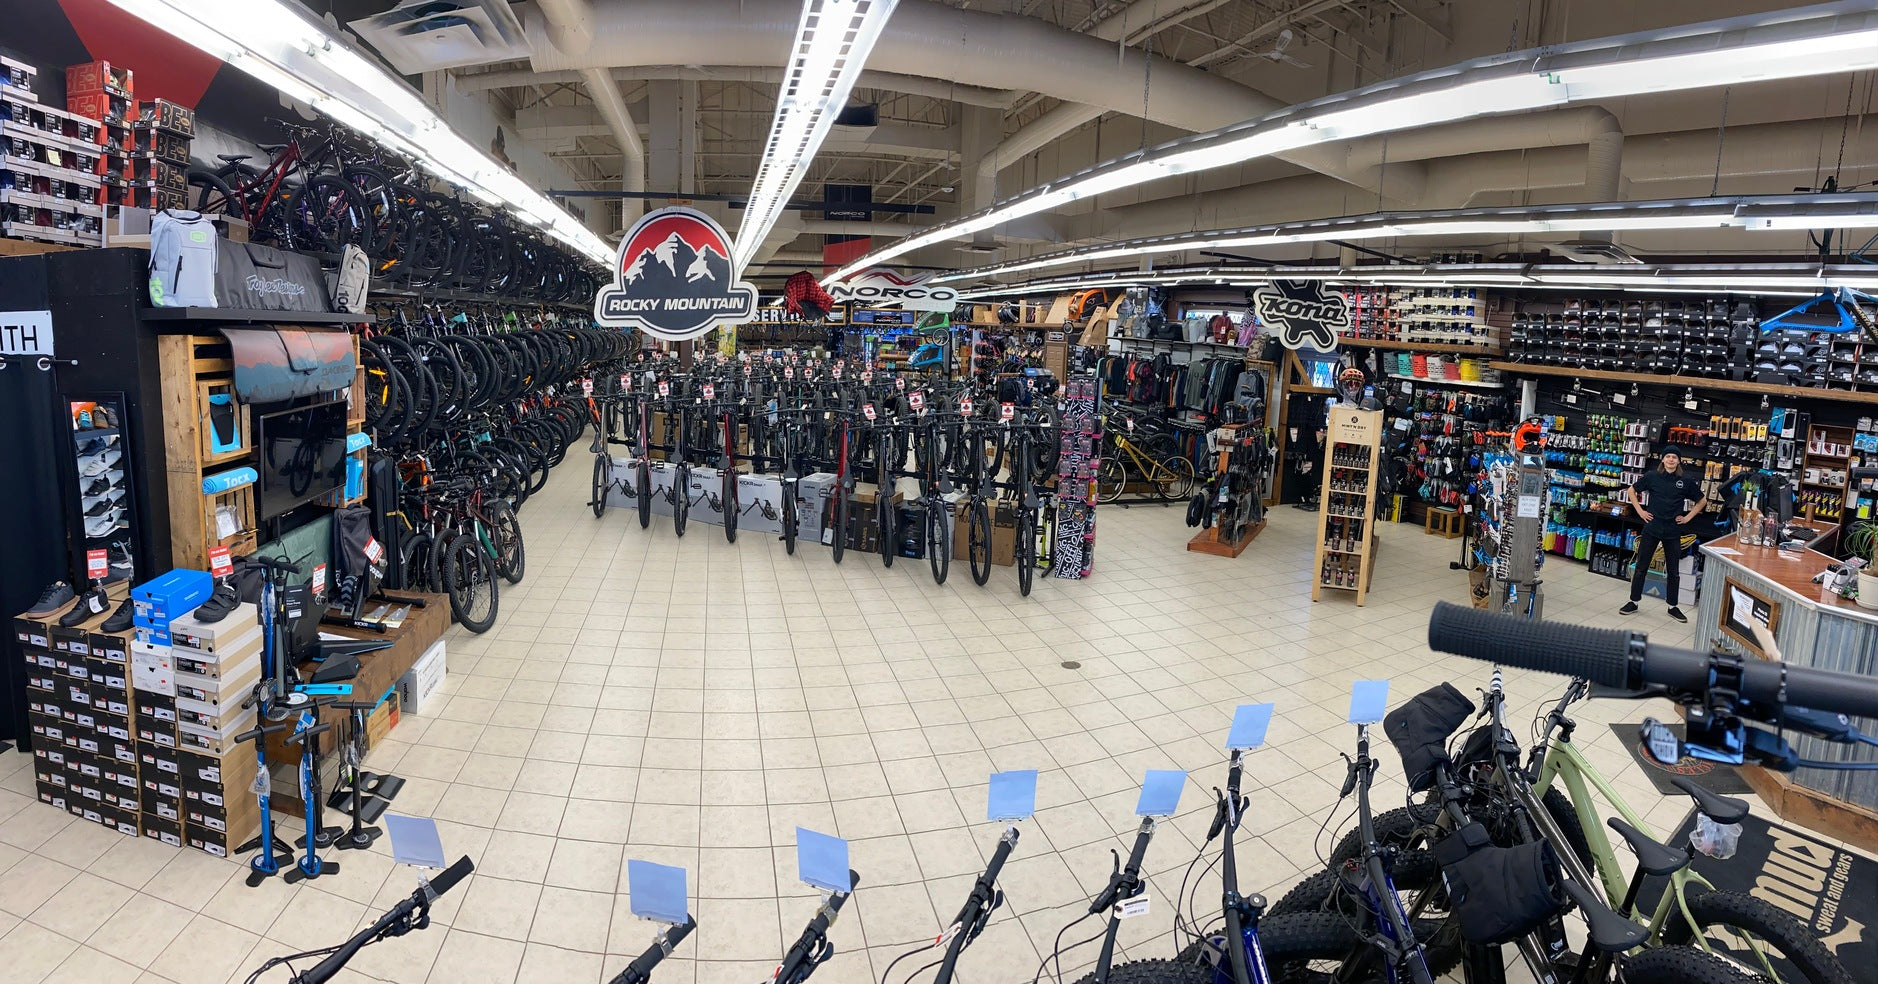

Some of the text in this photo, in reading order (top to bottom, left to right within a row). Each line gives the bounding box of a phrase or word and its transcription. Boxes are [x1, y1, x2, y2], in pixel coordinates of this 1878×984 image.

[830, 286, 955, 301] NORCO
[609, 297, 745, 312] ROCKY MOUNTAIN
[1815, 852, 1853, 934] sweat and gears
